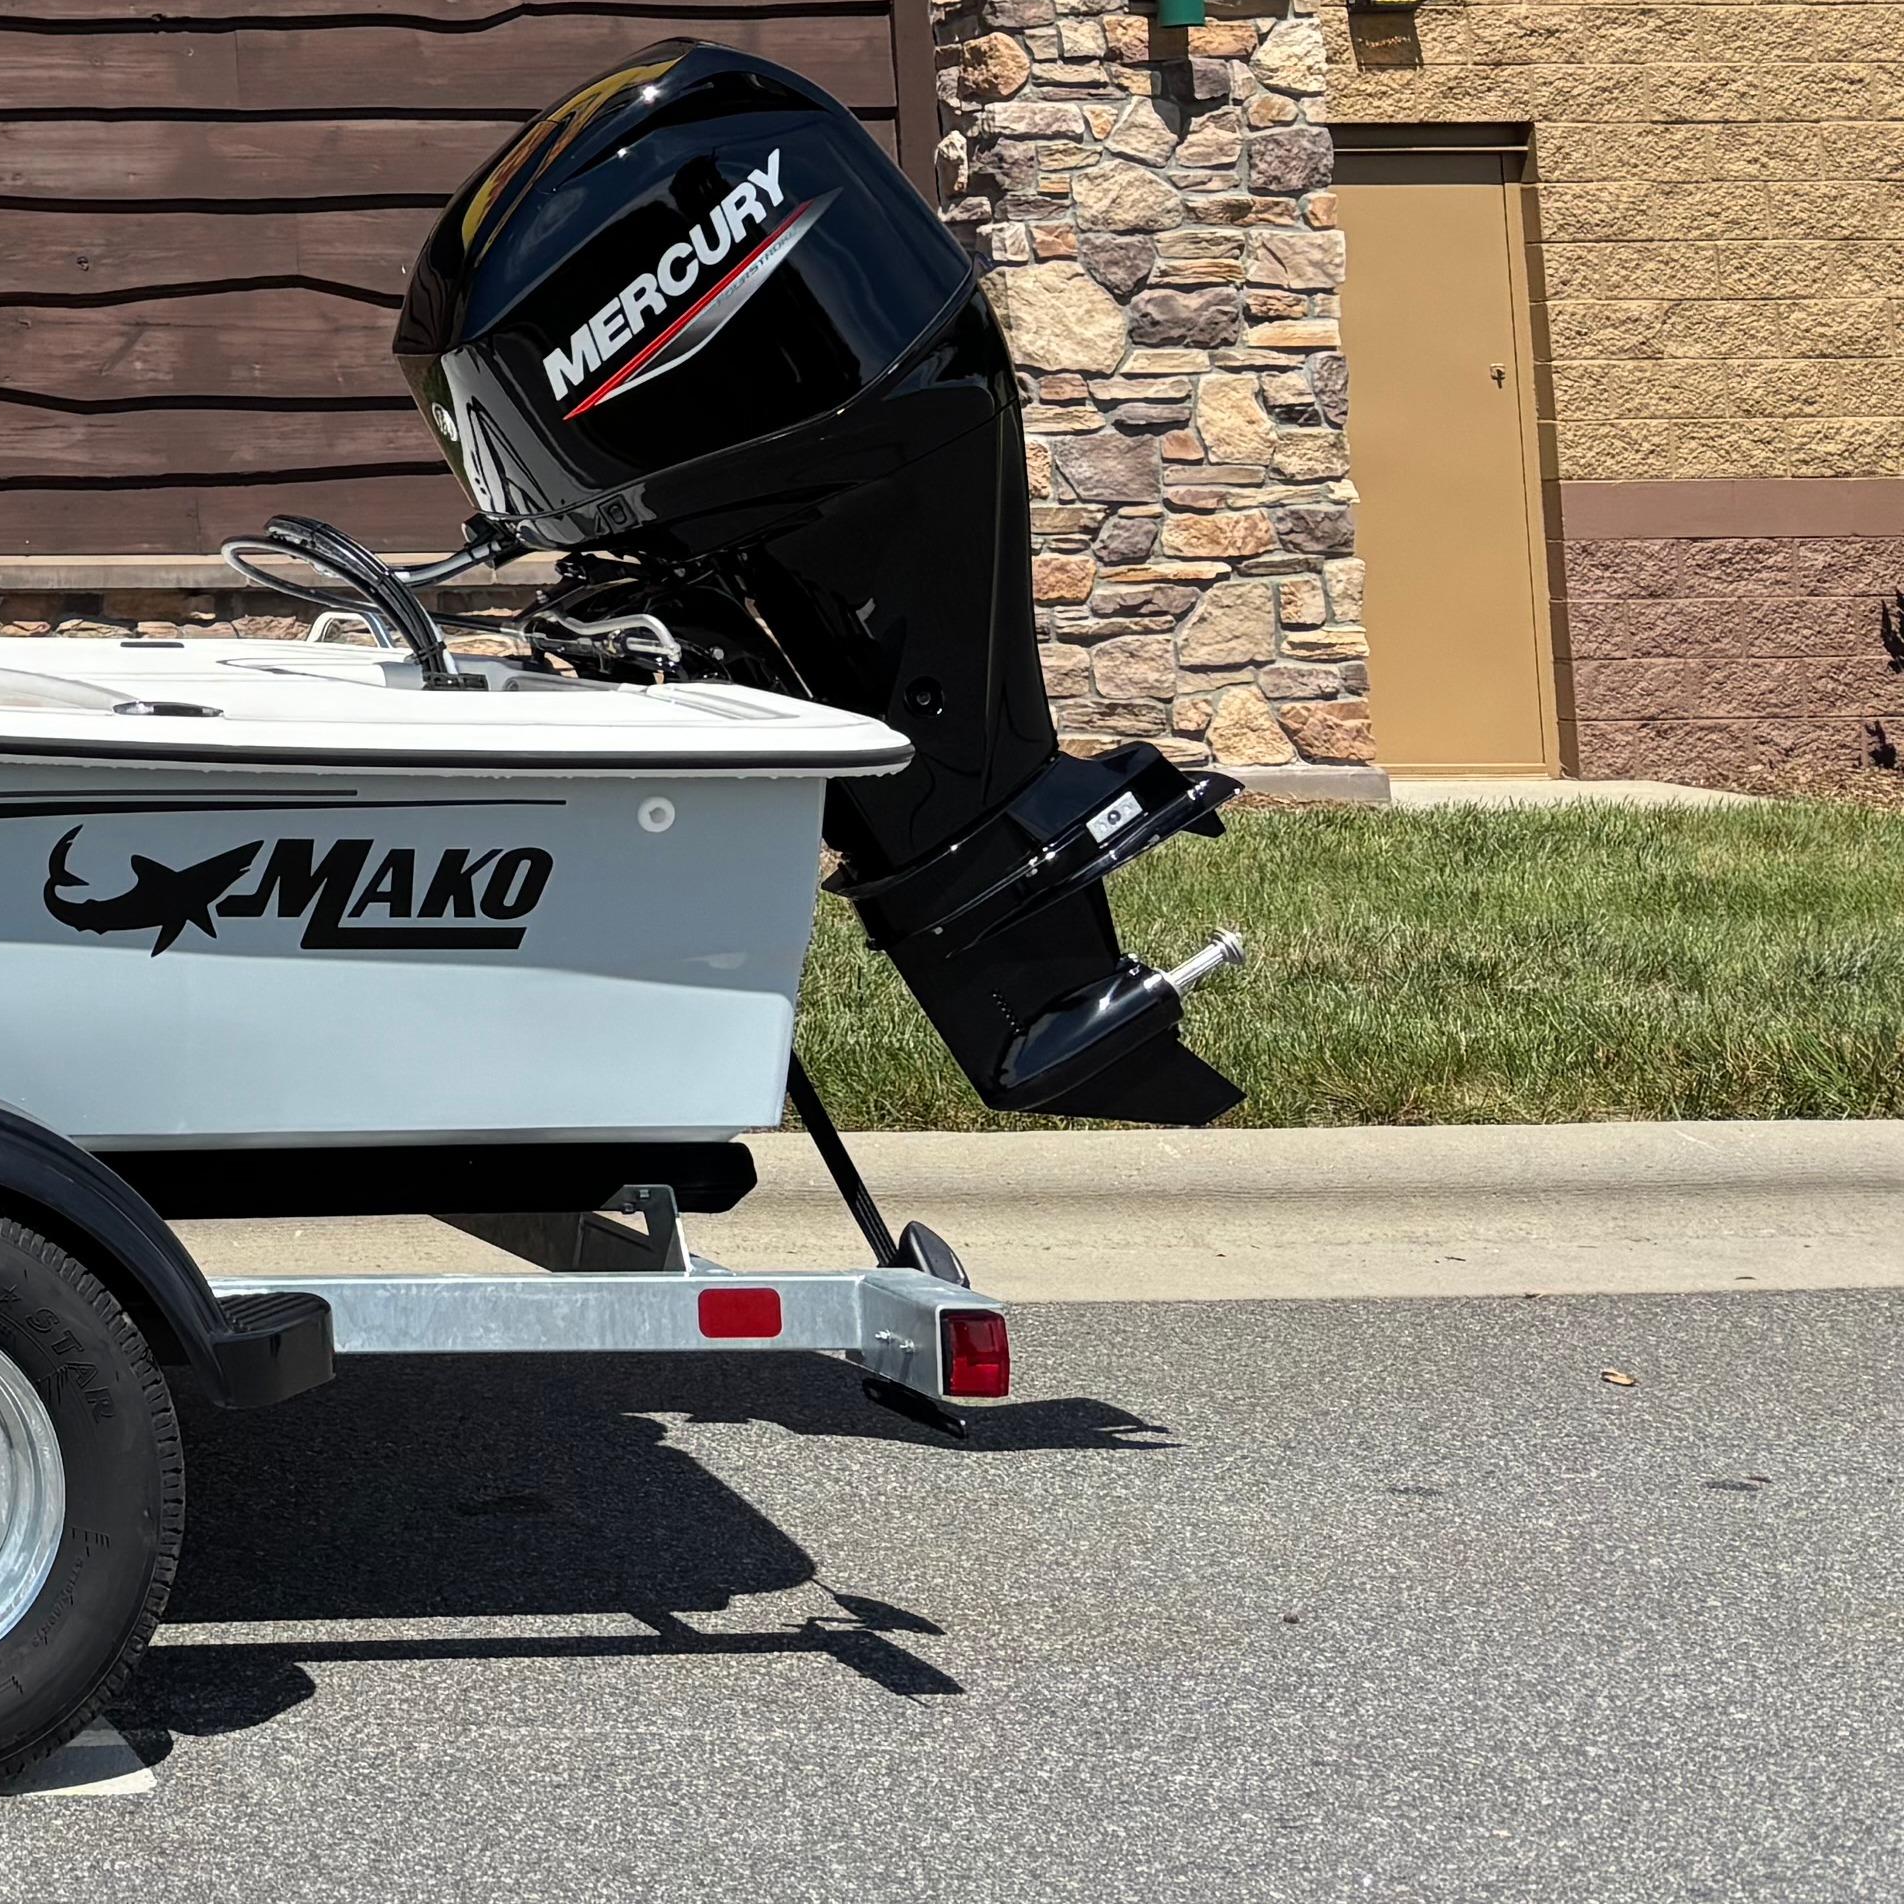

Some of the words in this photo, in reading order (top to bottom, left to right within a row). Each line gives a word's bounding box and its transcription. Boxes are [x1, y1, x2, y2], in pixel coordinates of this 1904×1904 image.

[542, 147, 784, 401] MERCURY
[215, 838, 554, 950] MAKO
[26, 1306, 115, 1423] STAR
